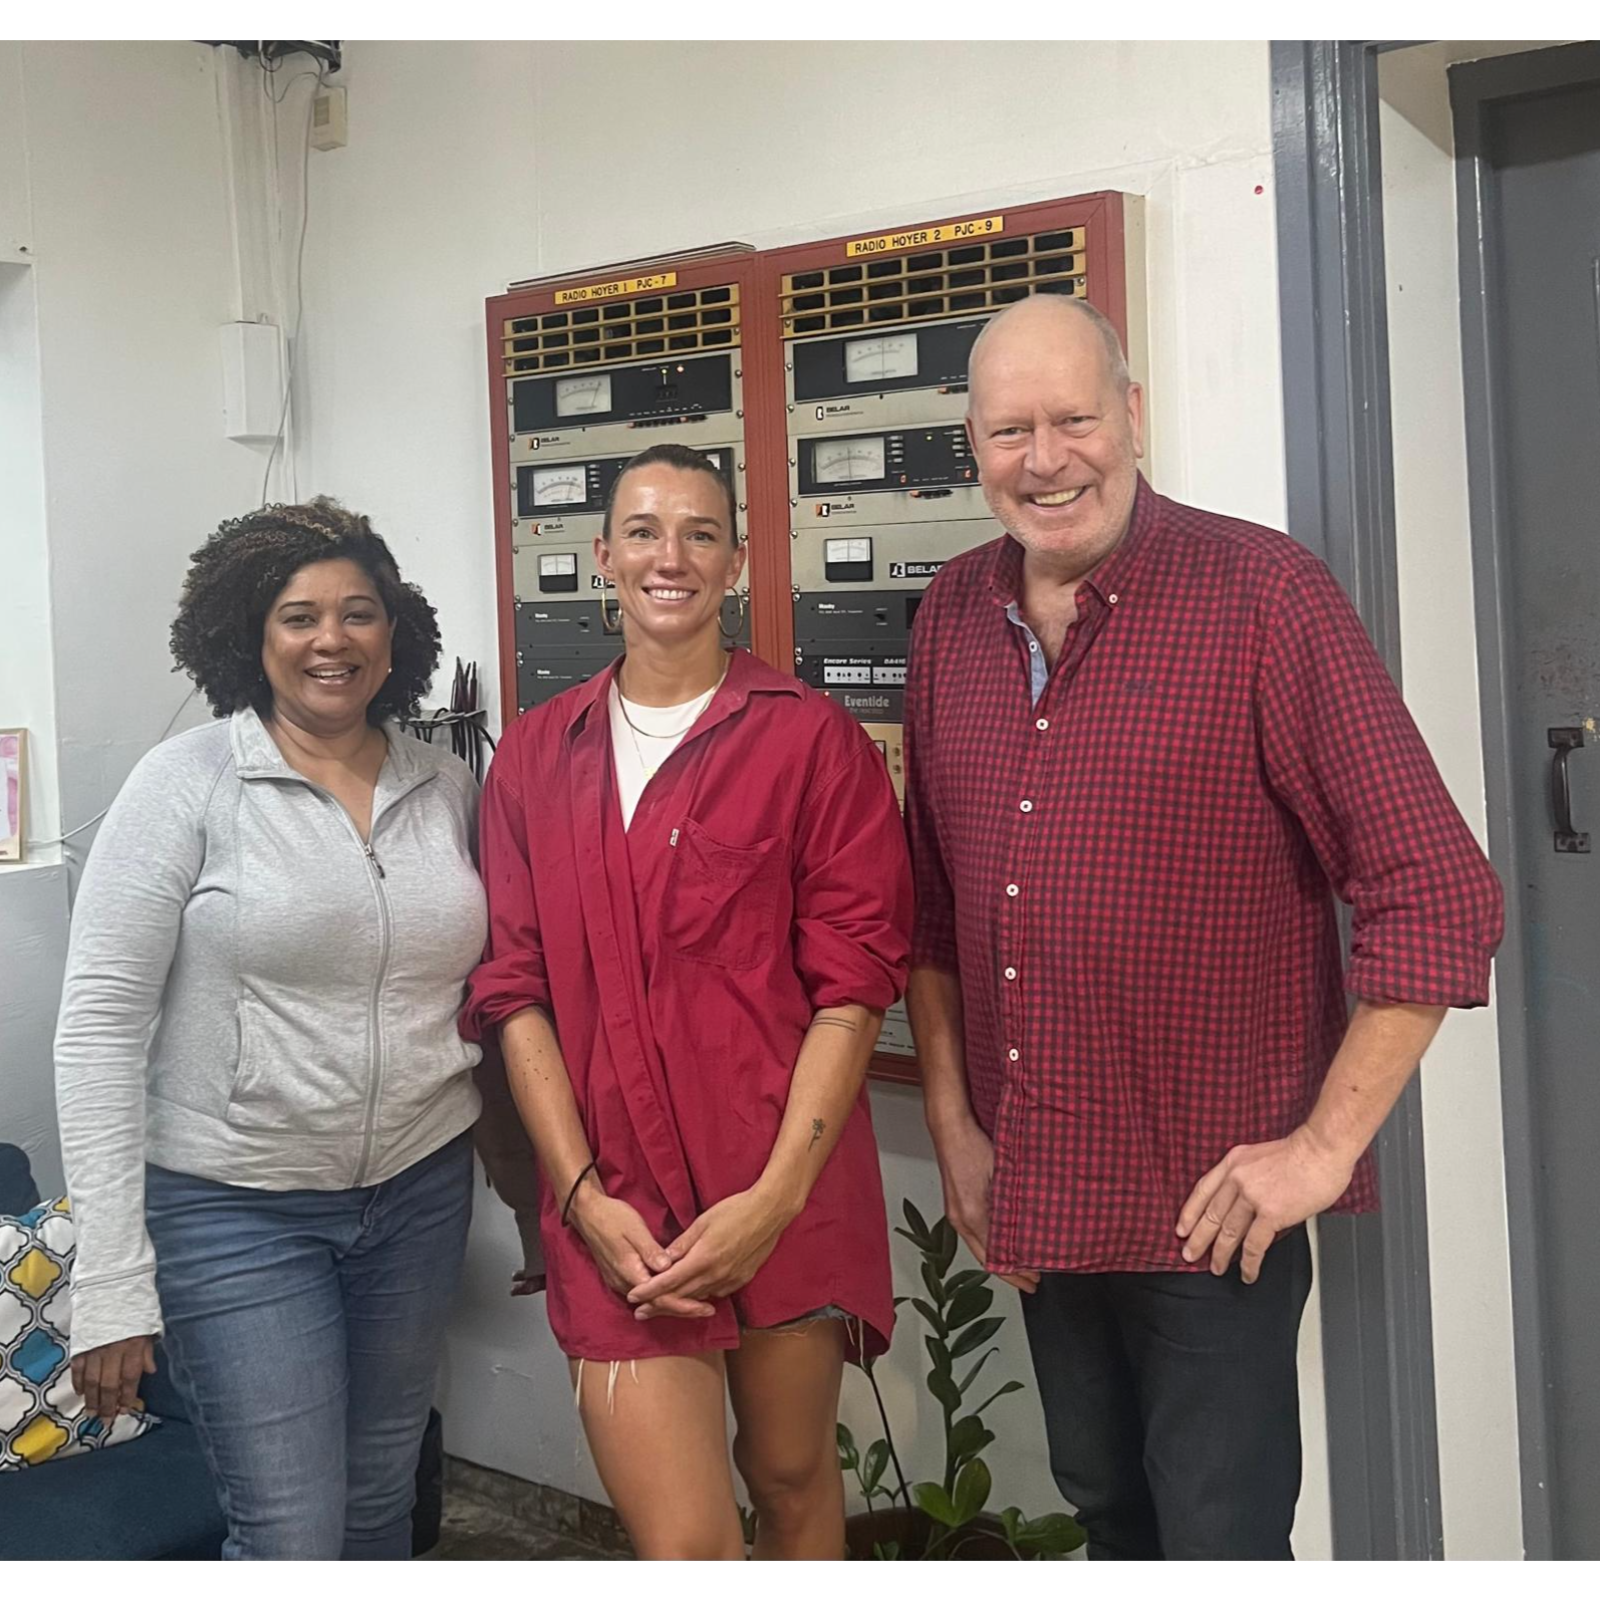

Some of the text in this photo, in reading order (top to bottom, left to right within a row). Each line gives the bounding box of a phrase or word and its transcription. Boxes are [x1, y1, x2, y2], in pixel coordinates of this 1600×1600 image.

[855, 239, 886, 253] RADIO
[892, 232, 928, 247] HOYER
[934, 229, 941, 241] 2
[562, 289, 587, 302] RADIO
[591, 284, 619, 297] HOYER
[823, 657, 848, 665] Encore
[849, 657, 872, 665] Series
[844, 694, 890, 708] Eventide
